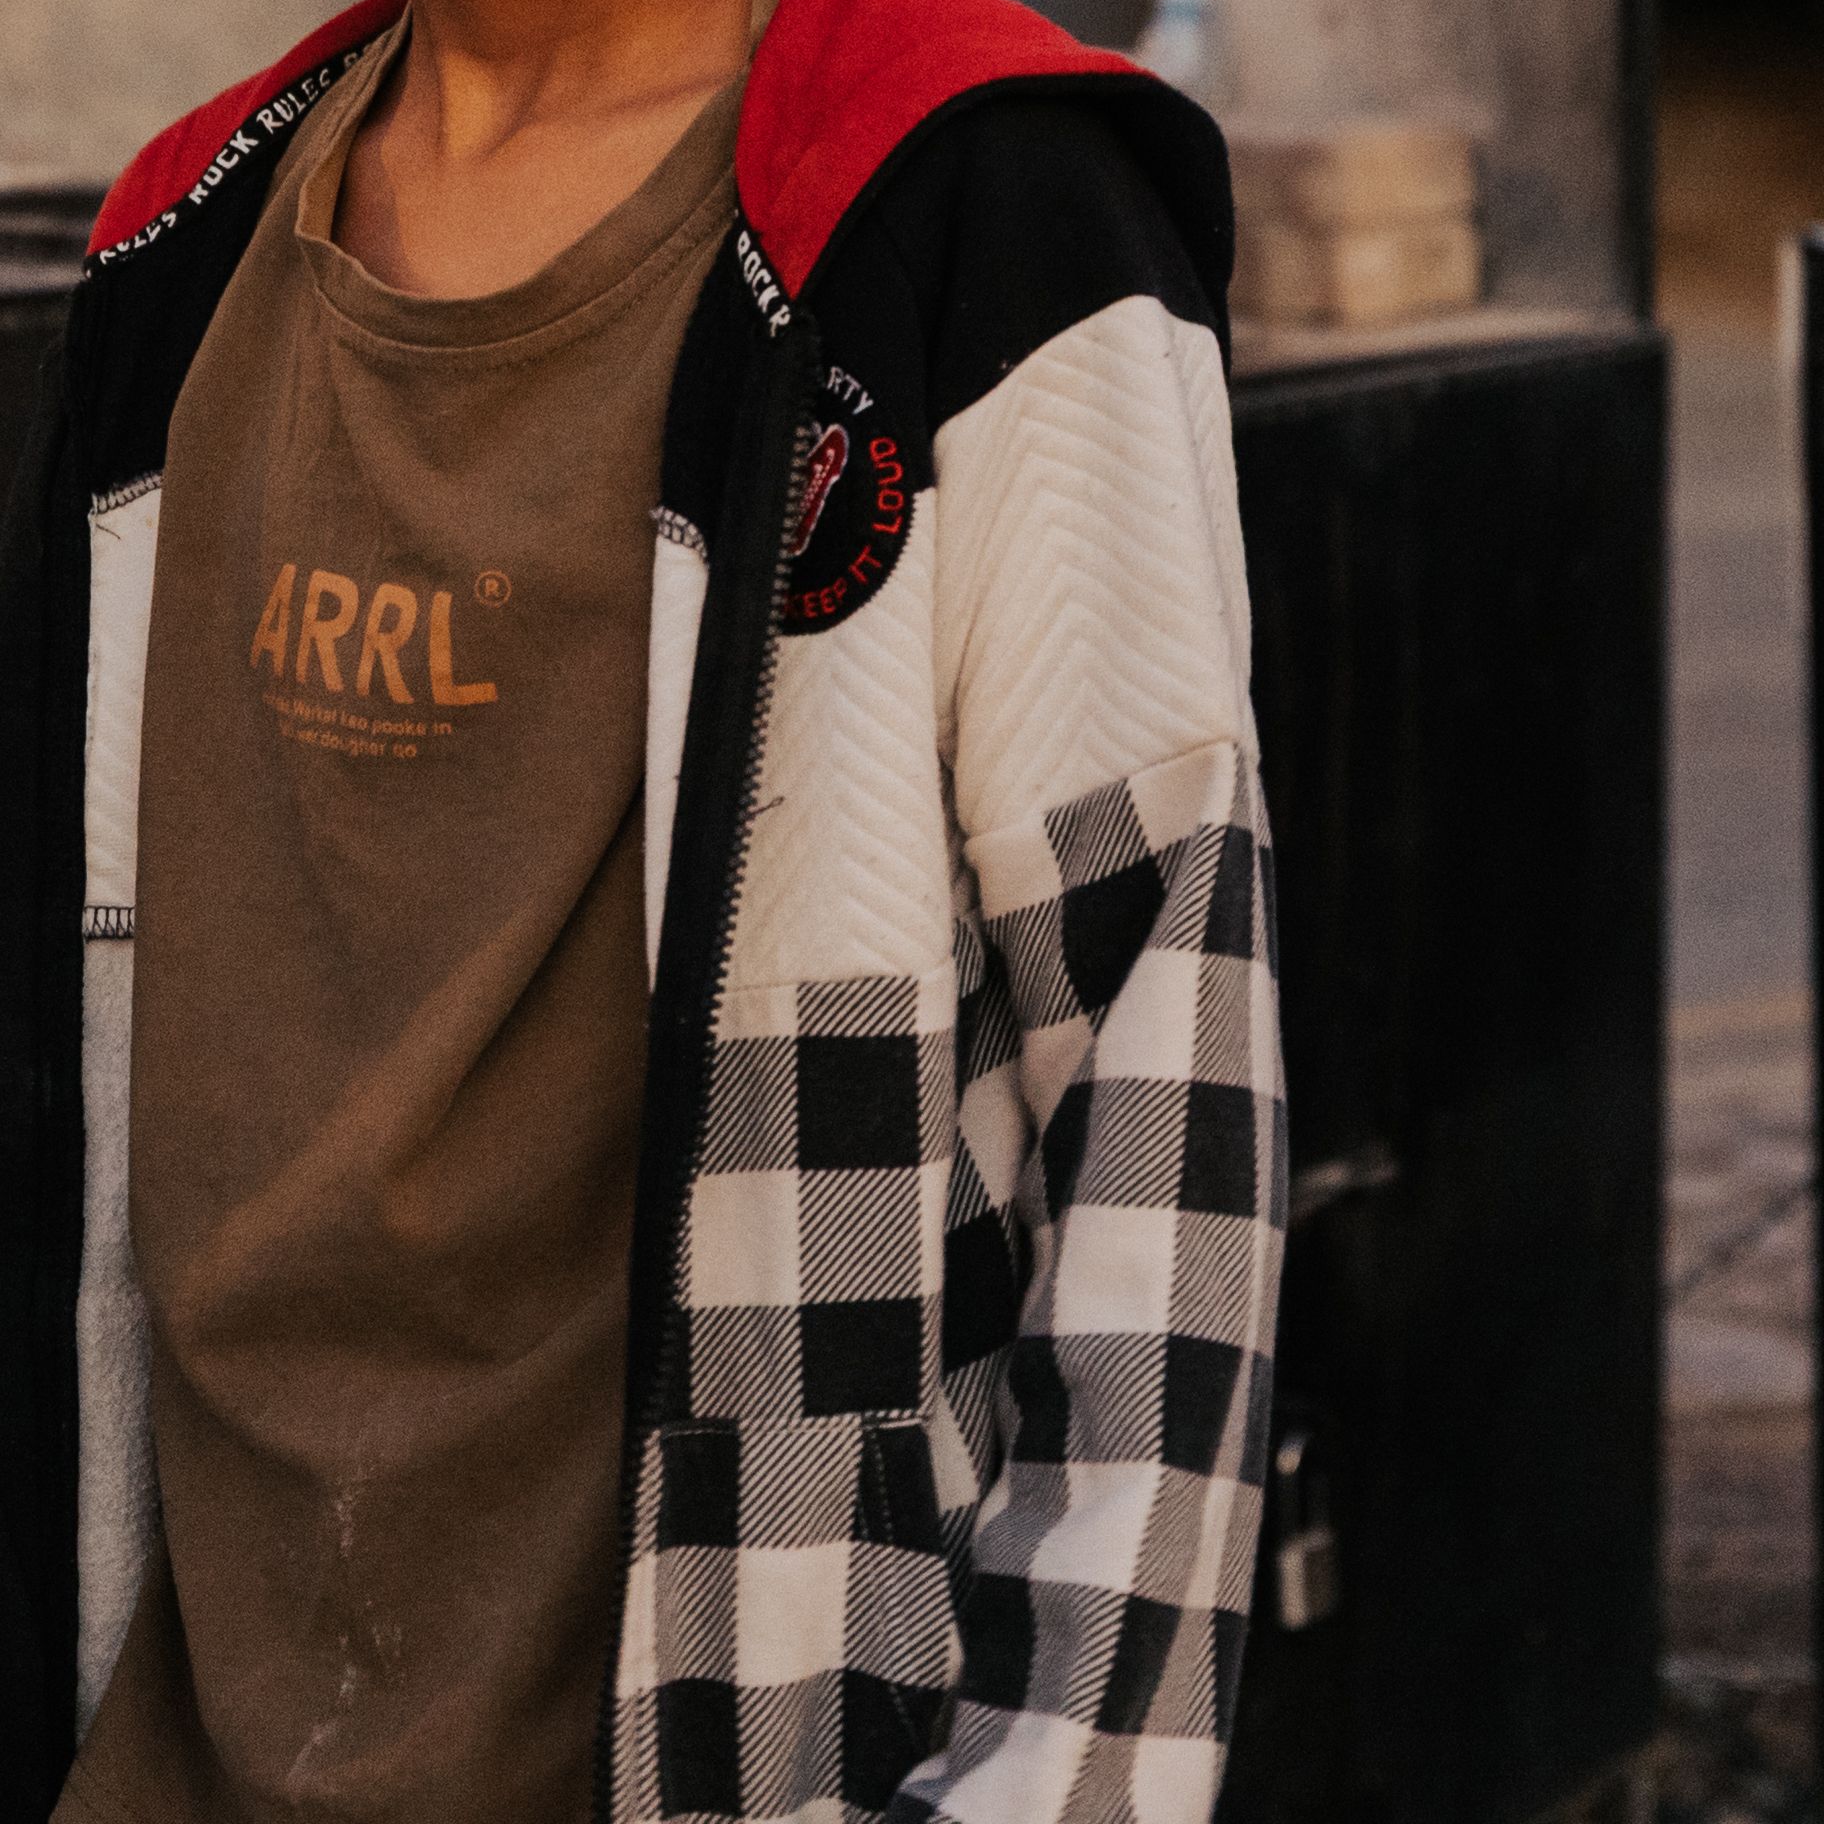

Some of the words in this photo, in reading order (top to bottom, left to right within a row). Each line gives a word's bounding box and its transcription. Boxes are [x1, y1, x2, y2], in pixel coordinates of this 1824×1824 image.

[737, 230, 780, 314] ROCK
[849, 543, 884, 586] IT
[867, 436, 906, 535] LOUD
